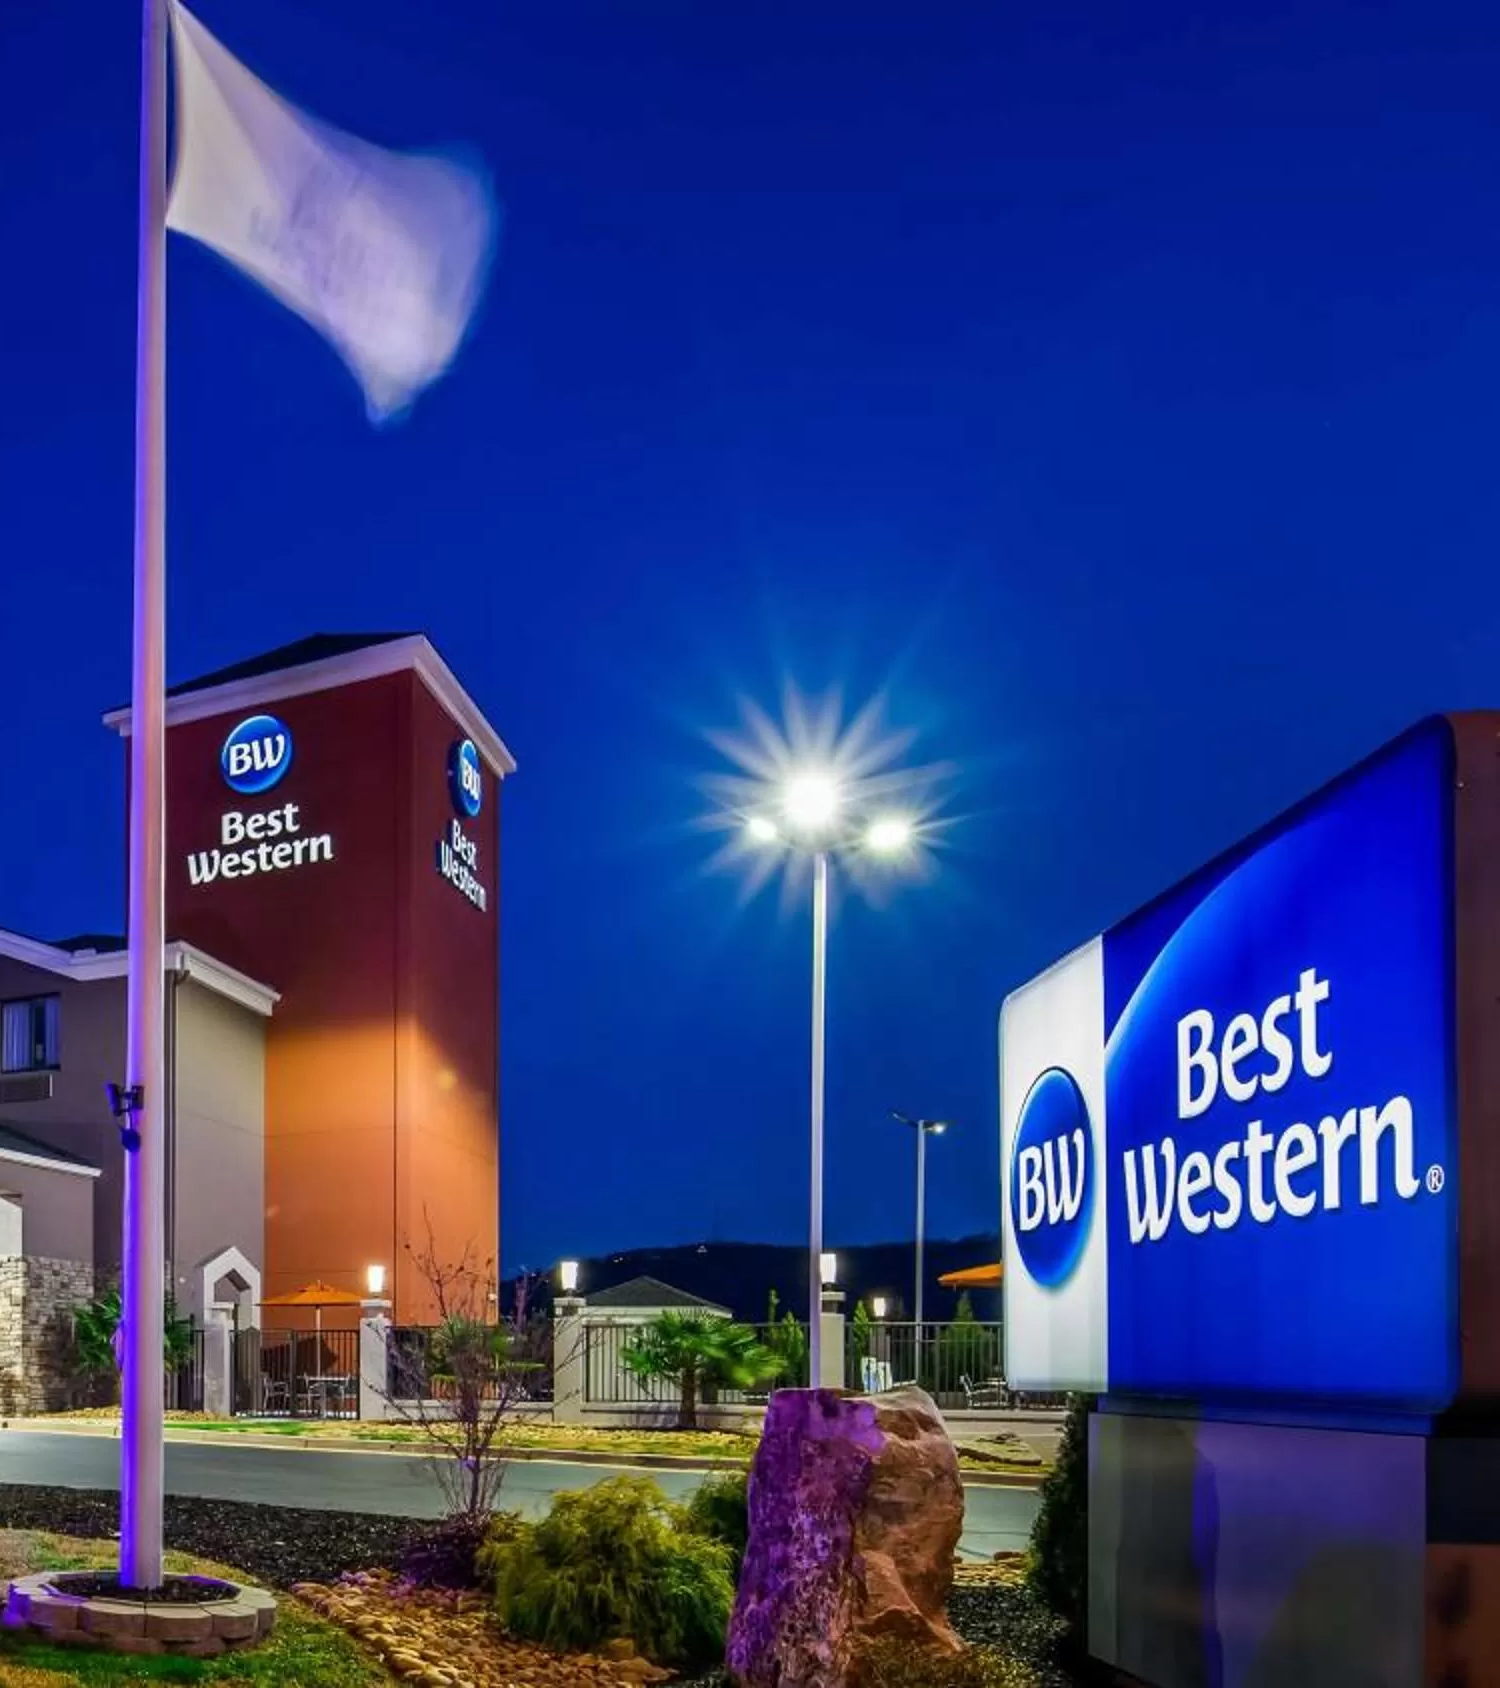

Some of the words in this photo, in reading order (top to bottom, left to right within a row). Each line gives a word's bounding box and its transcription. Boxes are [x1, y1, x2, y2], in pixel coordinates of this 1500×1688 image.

[228, 734, 285, 776] BW
[221, 803, 300, 846] Best
[452, 818, 478, 871] Best
[187, 834, 334, 885] Western
[441, 840, 487, 912] Western
[1177, 968, 1333, 1119] Best
[1018, 1128, 1085, 1232] BW
